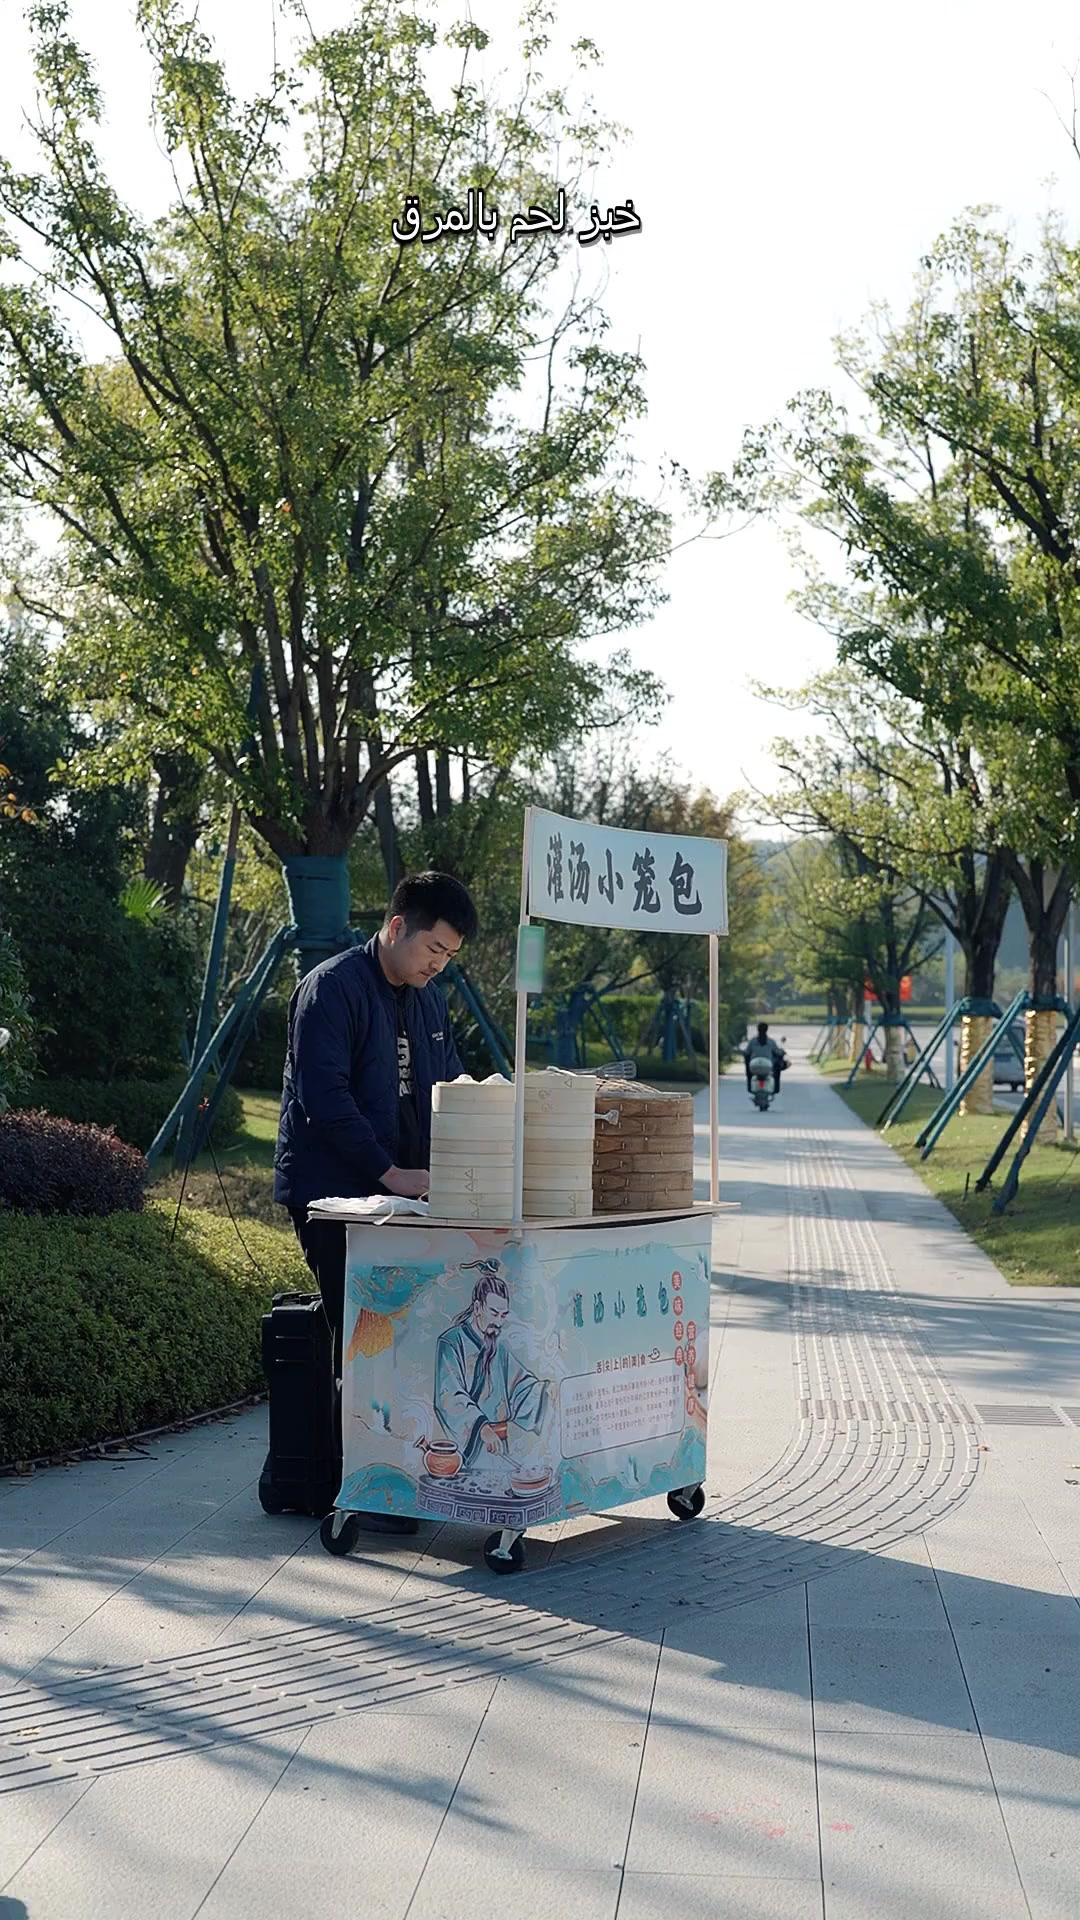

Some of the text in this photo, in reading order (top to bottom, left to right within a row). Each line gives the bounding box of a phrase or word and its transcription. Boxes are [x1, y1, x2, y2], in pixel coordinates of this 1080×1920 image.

[547, 832, 702, 915] 灌汤小笼包
